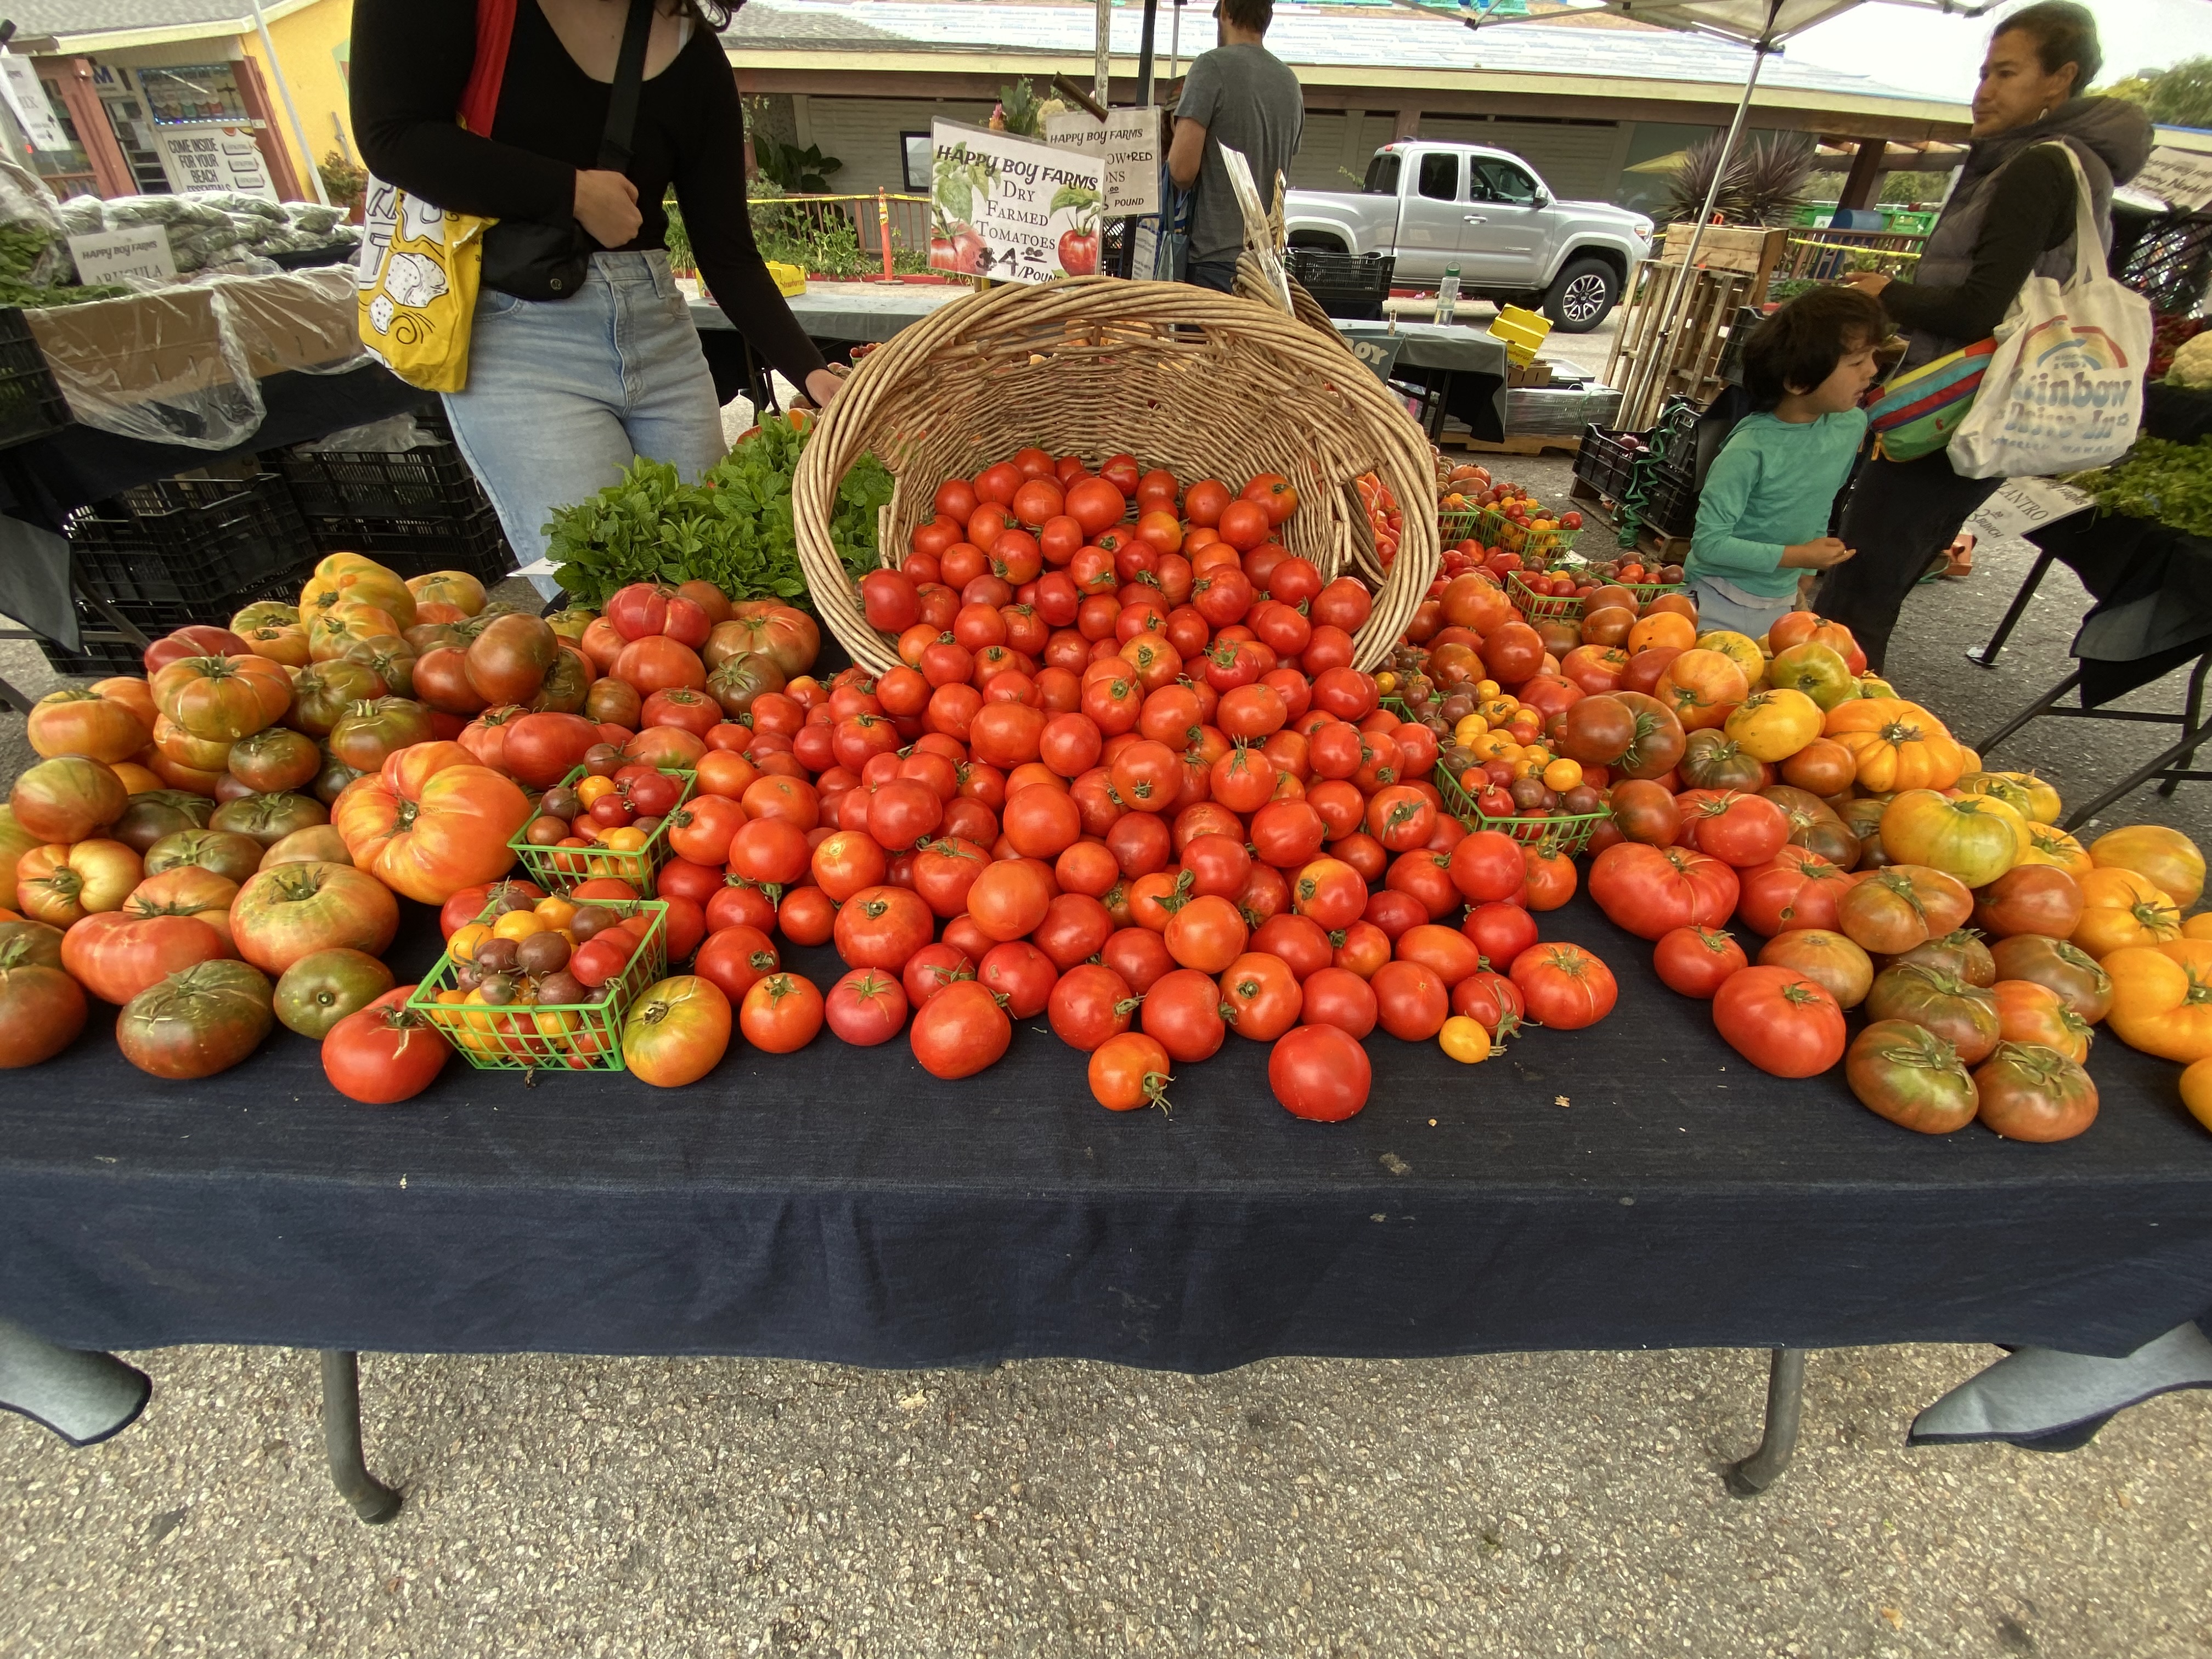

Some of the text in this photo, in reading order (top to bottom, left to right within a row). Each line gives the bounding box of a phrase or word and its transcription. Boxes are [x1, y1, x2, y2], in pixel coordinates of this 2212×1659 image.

[167, 138, 193, 154] COME
[191, 138, 218, 152] INSIDE
[1051, 128, 1143, 146] HAPPY BOY FARMS
[178, 154, 197, 168] FOR
[195, 154, 219, 167] YOUR
[936, 144, 1098, 191] HAPPY BOY FARMS
[190, 169, 219, 183] BEACH
[1003, 179, 1035, 202] DRY
[1114, 198, 1144, 207] POUND
[986, 200, 1049, 227] FARMED
[976, 220, 1056, 250] TOMATOES
[82, 240, 157, 259] HAPPY BOY FARMS
[1018, 266, 1063, 282] /POUN
[1976, 517, 2004, 538] BUNCH
